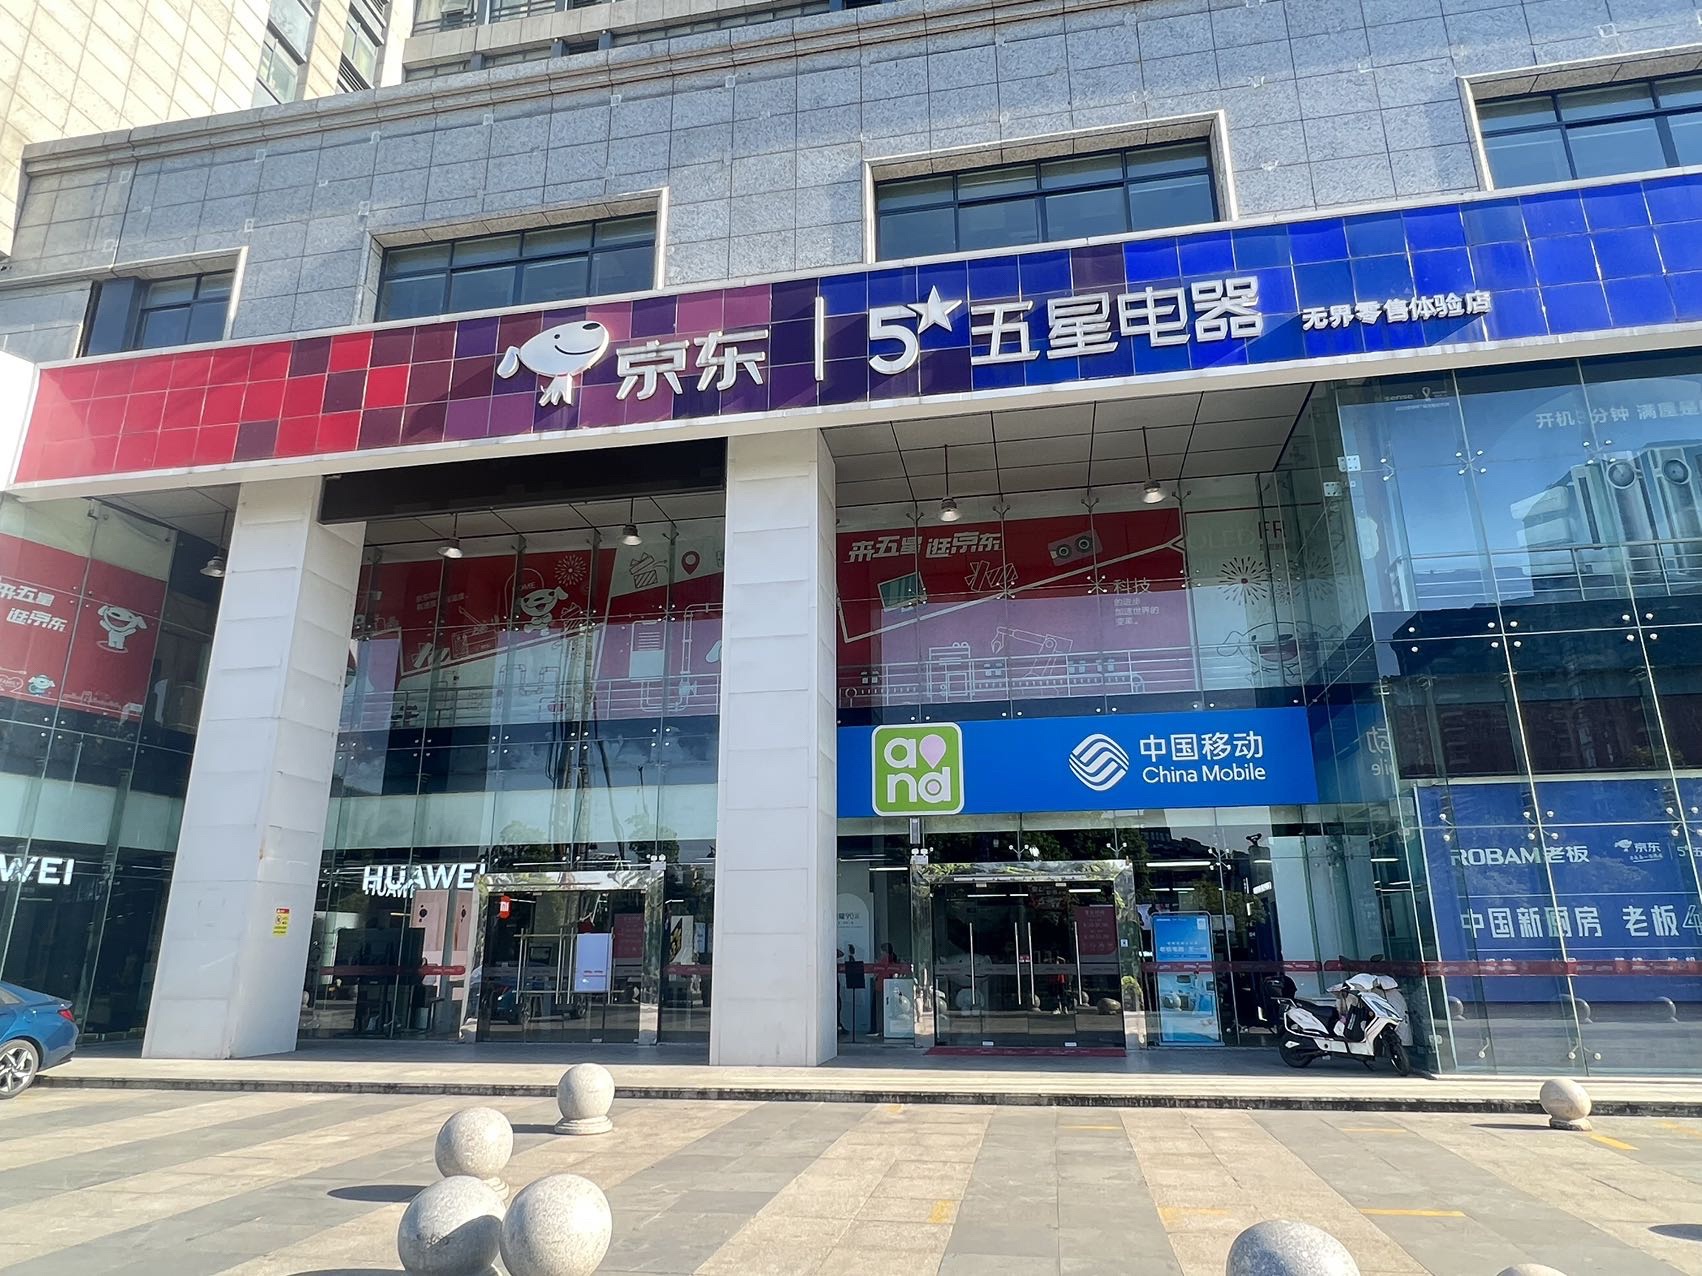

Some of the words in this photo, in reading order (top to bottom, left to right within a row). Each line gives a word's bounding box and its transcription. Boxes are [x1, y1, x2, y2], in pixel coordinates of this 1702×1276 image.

[616, 329, 769, 400] 京东
[971, 275, 1263, 365] 五星电器
[1302, 290, 1492, 331] 无界零售体验店
[1113, 577, 1151, 596] 科技
[6, 607, 68, 632] 逛京东
[1139, 731, 1263, 762] 中国移动
[1143, 766, 1198, 783] China
[1202, 763, 1267, 782] Mobile
[0, 853, 74, 885] WEI
[1461, 906, 1602, 938] 中国新厨房
